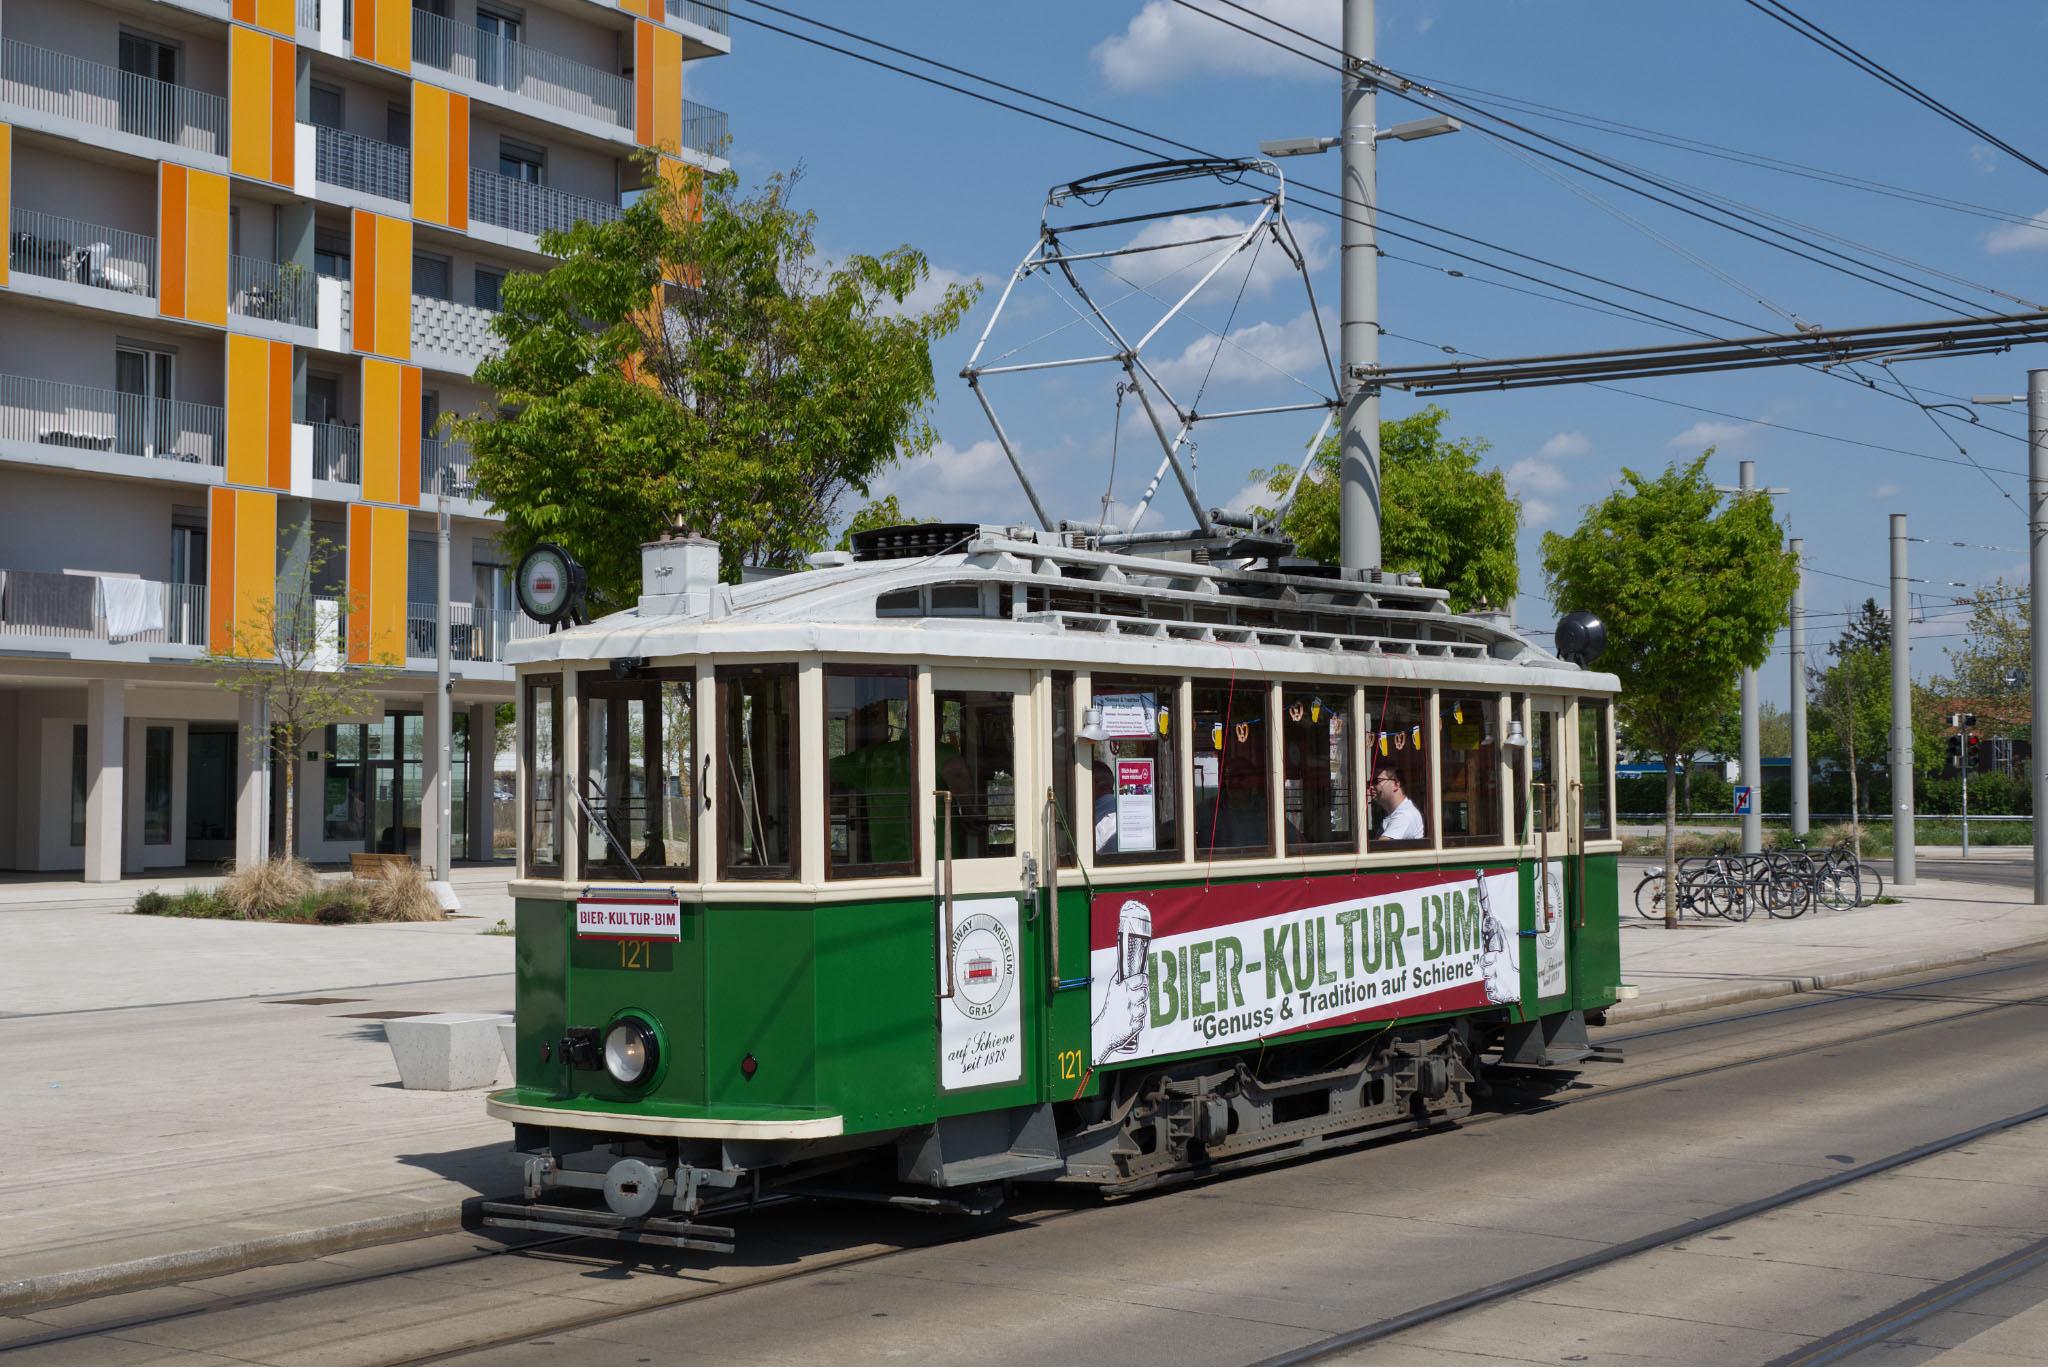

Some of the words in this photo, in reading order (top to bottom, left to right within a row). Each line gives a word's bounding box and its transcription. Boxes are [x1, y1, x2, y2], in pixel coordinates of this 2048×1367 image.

[617, 940, 650, 969] 121
[992, 922, 1013, 976] MUSEUM
[1149, 887, 1481, 1029] BIER-KULTUR-BIM
[968, 1003, 994, 1017] GRAZ
[1280, 996, 1294, 1021] &
[1299, 978, 1377, 1015] Tradition
[1381, 969, 1407, 996] auf
[947, 1037, 971, 1065] auf
[971, 1030, 1016, 1055] Schiene
[961, 1055, 982, 1074] seit
[984, 1048, 1007, 1067] 1878
[1057, 1049, 1082, 1080] 121
